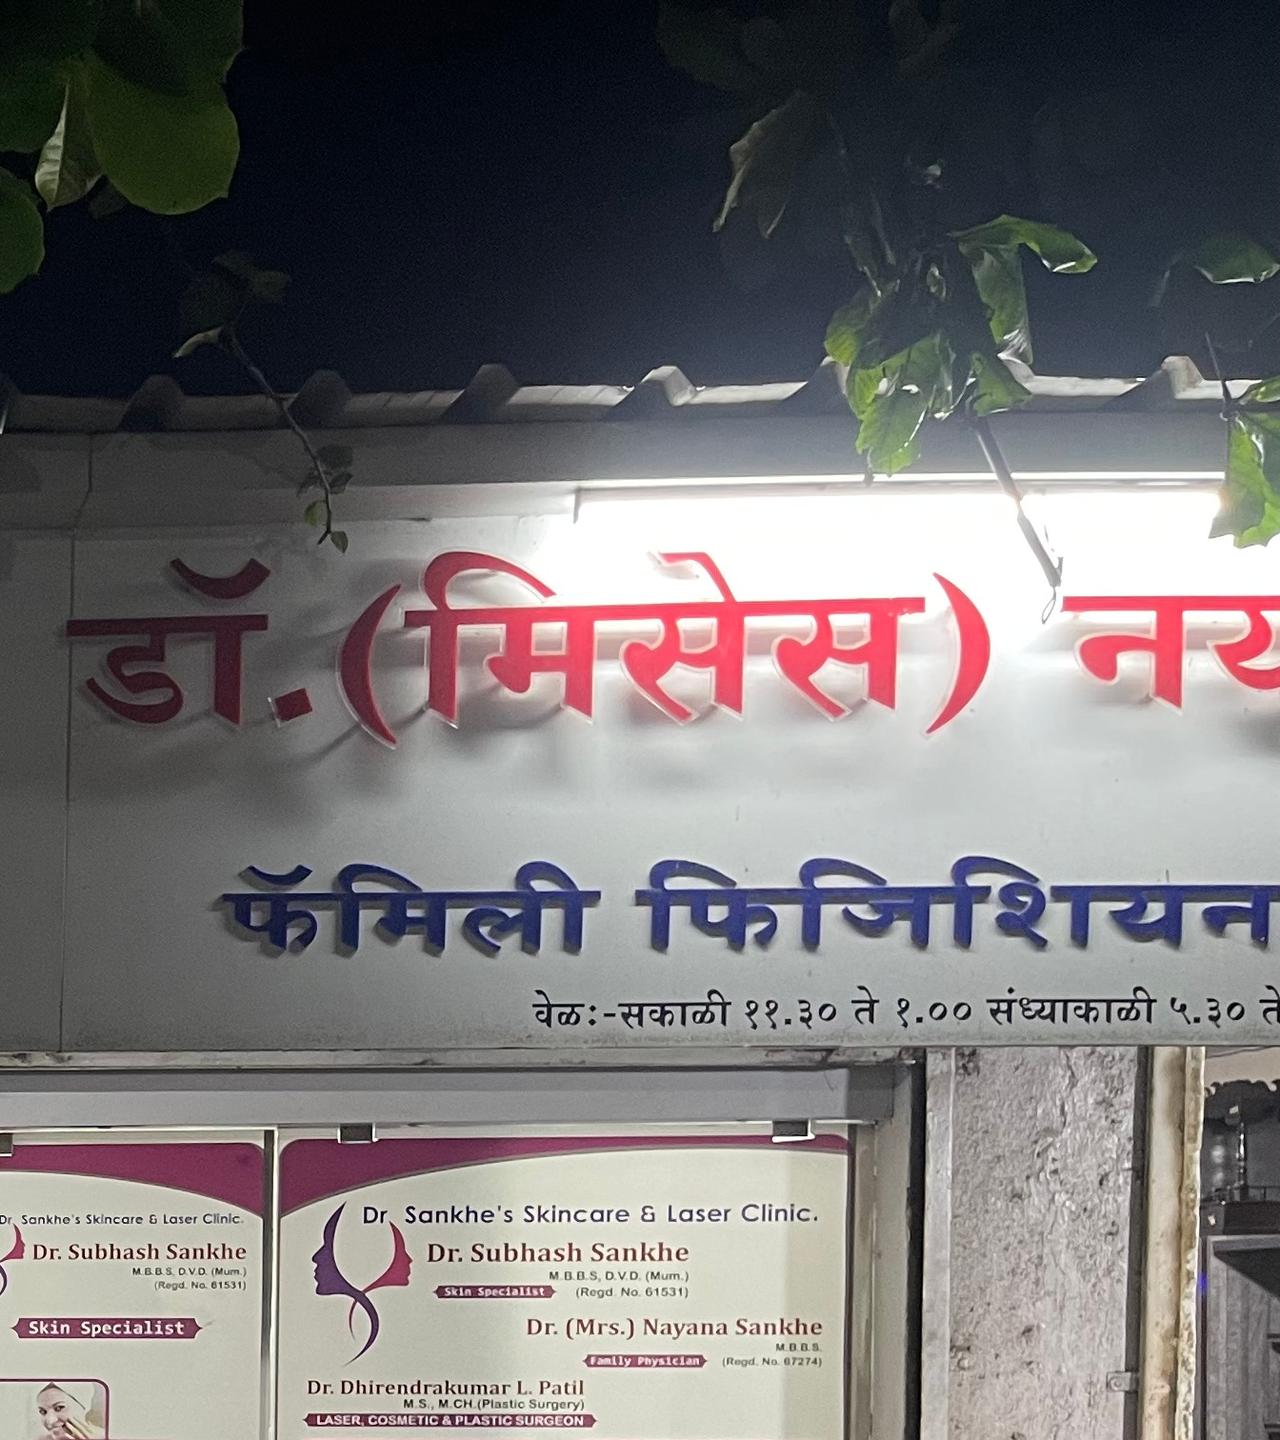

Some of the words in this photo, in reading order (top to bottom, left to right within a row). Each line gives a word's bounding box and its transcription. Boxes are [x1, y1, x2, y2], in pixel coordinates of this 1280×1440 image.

[222, 859, 602, 955] फॅमिली
[851, 986, 878, 1026] ते
[987, 986, 1157, 1025] संध्याकाळी
[21, 1213, 81, 1225] Sankhe's
[86, 1213, 144, 1225] Skincare
[150, 1213, 158, 1225] &
[163, 1213, 198, 1225] Laser
[404, 1205, 514, 1224] Sankhe's
[523, 1205, 631, 1224] Skincare
[641, 1205, 655, 1224] &
[666, 1205, 730, 1224] Laser
[740, 1205, 819, 1224] Clinic.
[32, 1243, 62, 1261] Dr.
[68, 1243, 159, 1261] Subhash
[166, 1243, 247, 1261] Sankhe
[426, 1242, 462, 1264] Dr.
[471, 1242, 583, 1264] Subhash
[590, 1242, 690, 1264] Sankhe
[443, 1286, 470, 1298] Skin
[477, 1286, 545, 1298] Specialist
[28, 1320, 70, 1337] Skin
[81, 1320, 185, 1337] Specialist
[526, 1317, 559, 1341] Dr.
[565, 1317, 635, 1341] (Mrs.)
[642, 1317, 729, 1341] Nayana
[735, 1317, 824, 1341] Sankhe
[590, 1356, 630, 1368] Family
[636, 1356, 701, 1368] Physician
[306, 1379, 336, 1396] Dr.
[339, 1379, 511, 1396] Dhirendrakumar
[516, 1379, 533, 1396] L.
[538, 1379, 584, 1396] Patil
[368, 1415, 439, 1428] COSMETIC
[442, 1415, 453, 1428] &
[455, 1415, 512, 1428] PLASTIC
[515, 1415, 584, 1428] SURGEON
